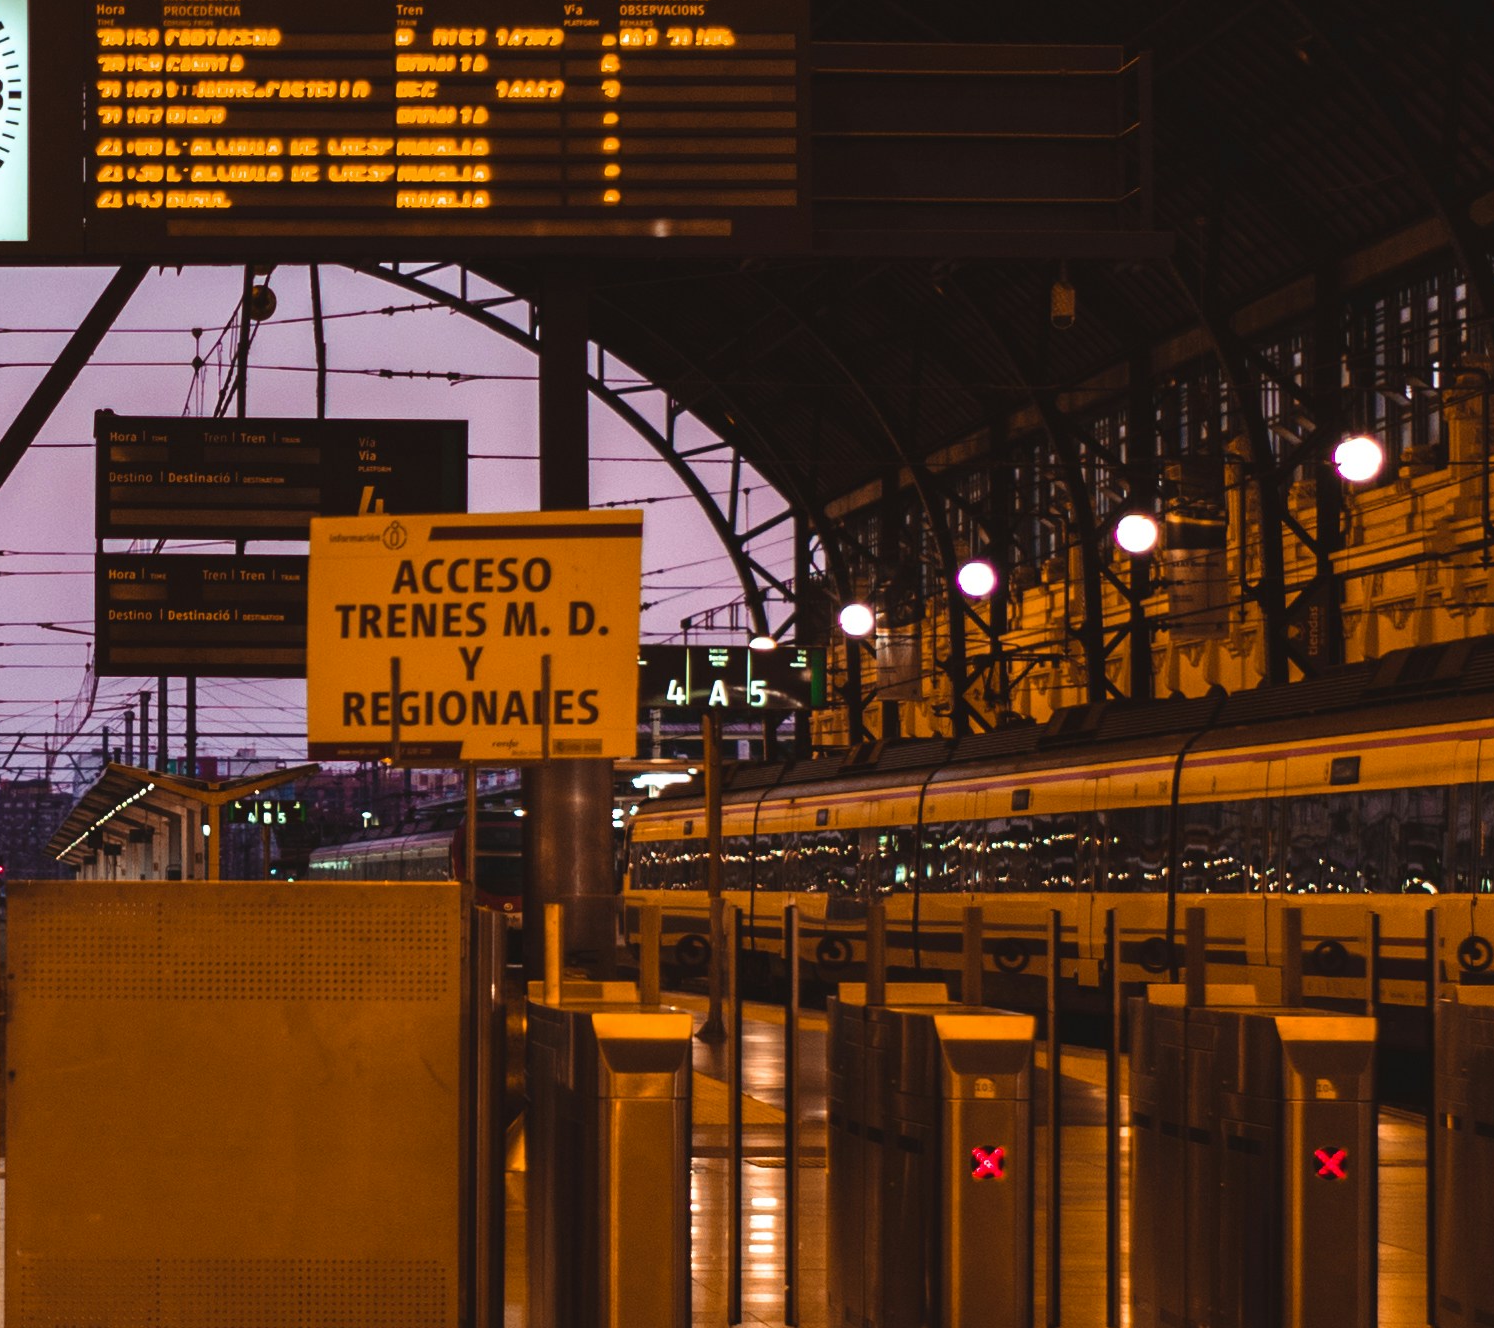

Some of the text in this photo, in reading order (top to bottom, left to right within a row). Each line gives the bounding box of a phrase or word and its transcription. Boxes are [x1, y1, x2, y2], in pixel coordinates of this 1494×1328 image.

[96, 4, 126, 16] Hora
[395, 4, 424, 16] Tren
[619, 4, 705, 16] OBSERVACIONS
[109, 432, 138, 442] Hora
[203, 432, 266, 443] Tren Tren
[109, 471, 153, 483] Destino
[168, 471, 231, 483] Destinació
[329, 532, 381, 544] información
[108, 569, 136, 580] Hora
[202, 569, 265, 581] Tren Tren
[391, 557, 552, 594] ACCESO
[108, 609, 152, 621] Destino
[167, 609, 230, 621] Destinació
[335, 601, 610, 638] TRENES M. D.
[458, 646, 485, 681] Y
[666, 679, 686, 706] 4
[708, 679, 730, 707] A
[750, 680, 768, 707] 5
[342, 689, 601, 727] REGIONALES
